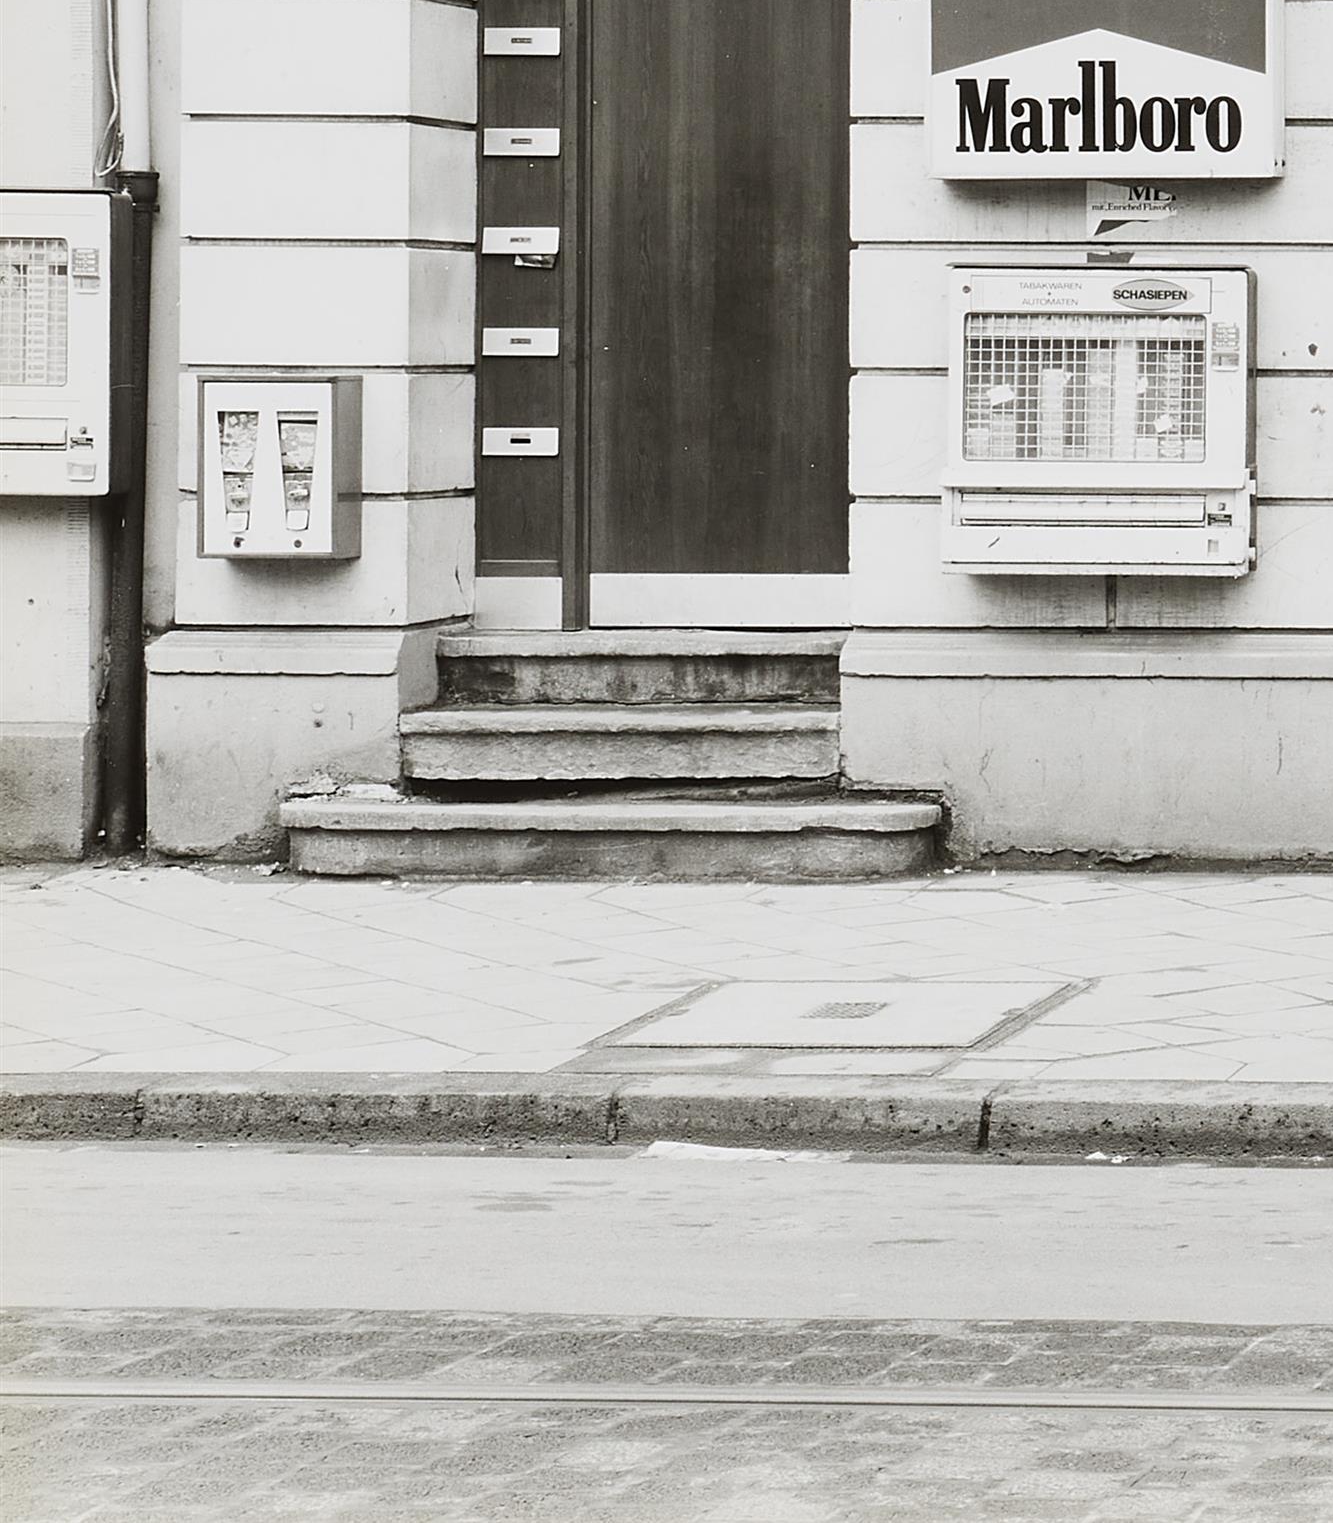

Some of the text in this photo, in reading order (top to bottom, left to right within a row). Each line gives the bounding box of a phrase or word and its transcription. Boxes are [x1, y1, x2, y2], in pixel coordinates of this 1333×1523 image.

[955, 60, 1242, 154] Marlboro
[1019, 281, 1082, 290] TABAKWAREN
[1112, 290, 1188, 301] SCHASIEPEN
[1022, 298, 1078, 306] AUTOMATEN
